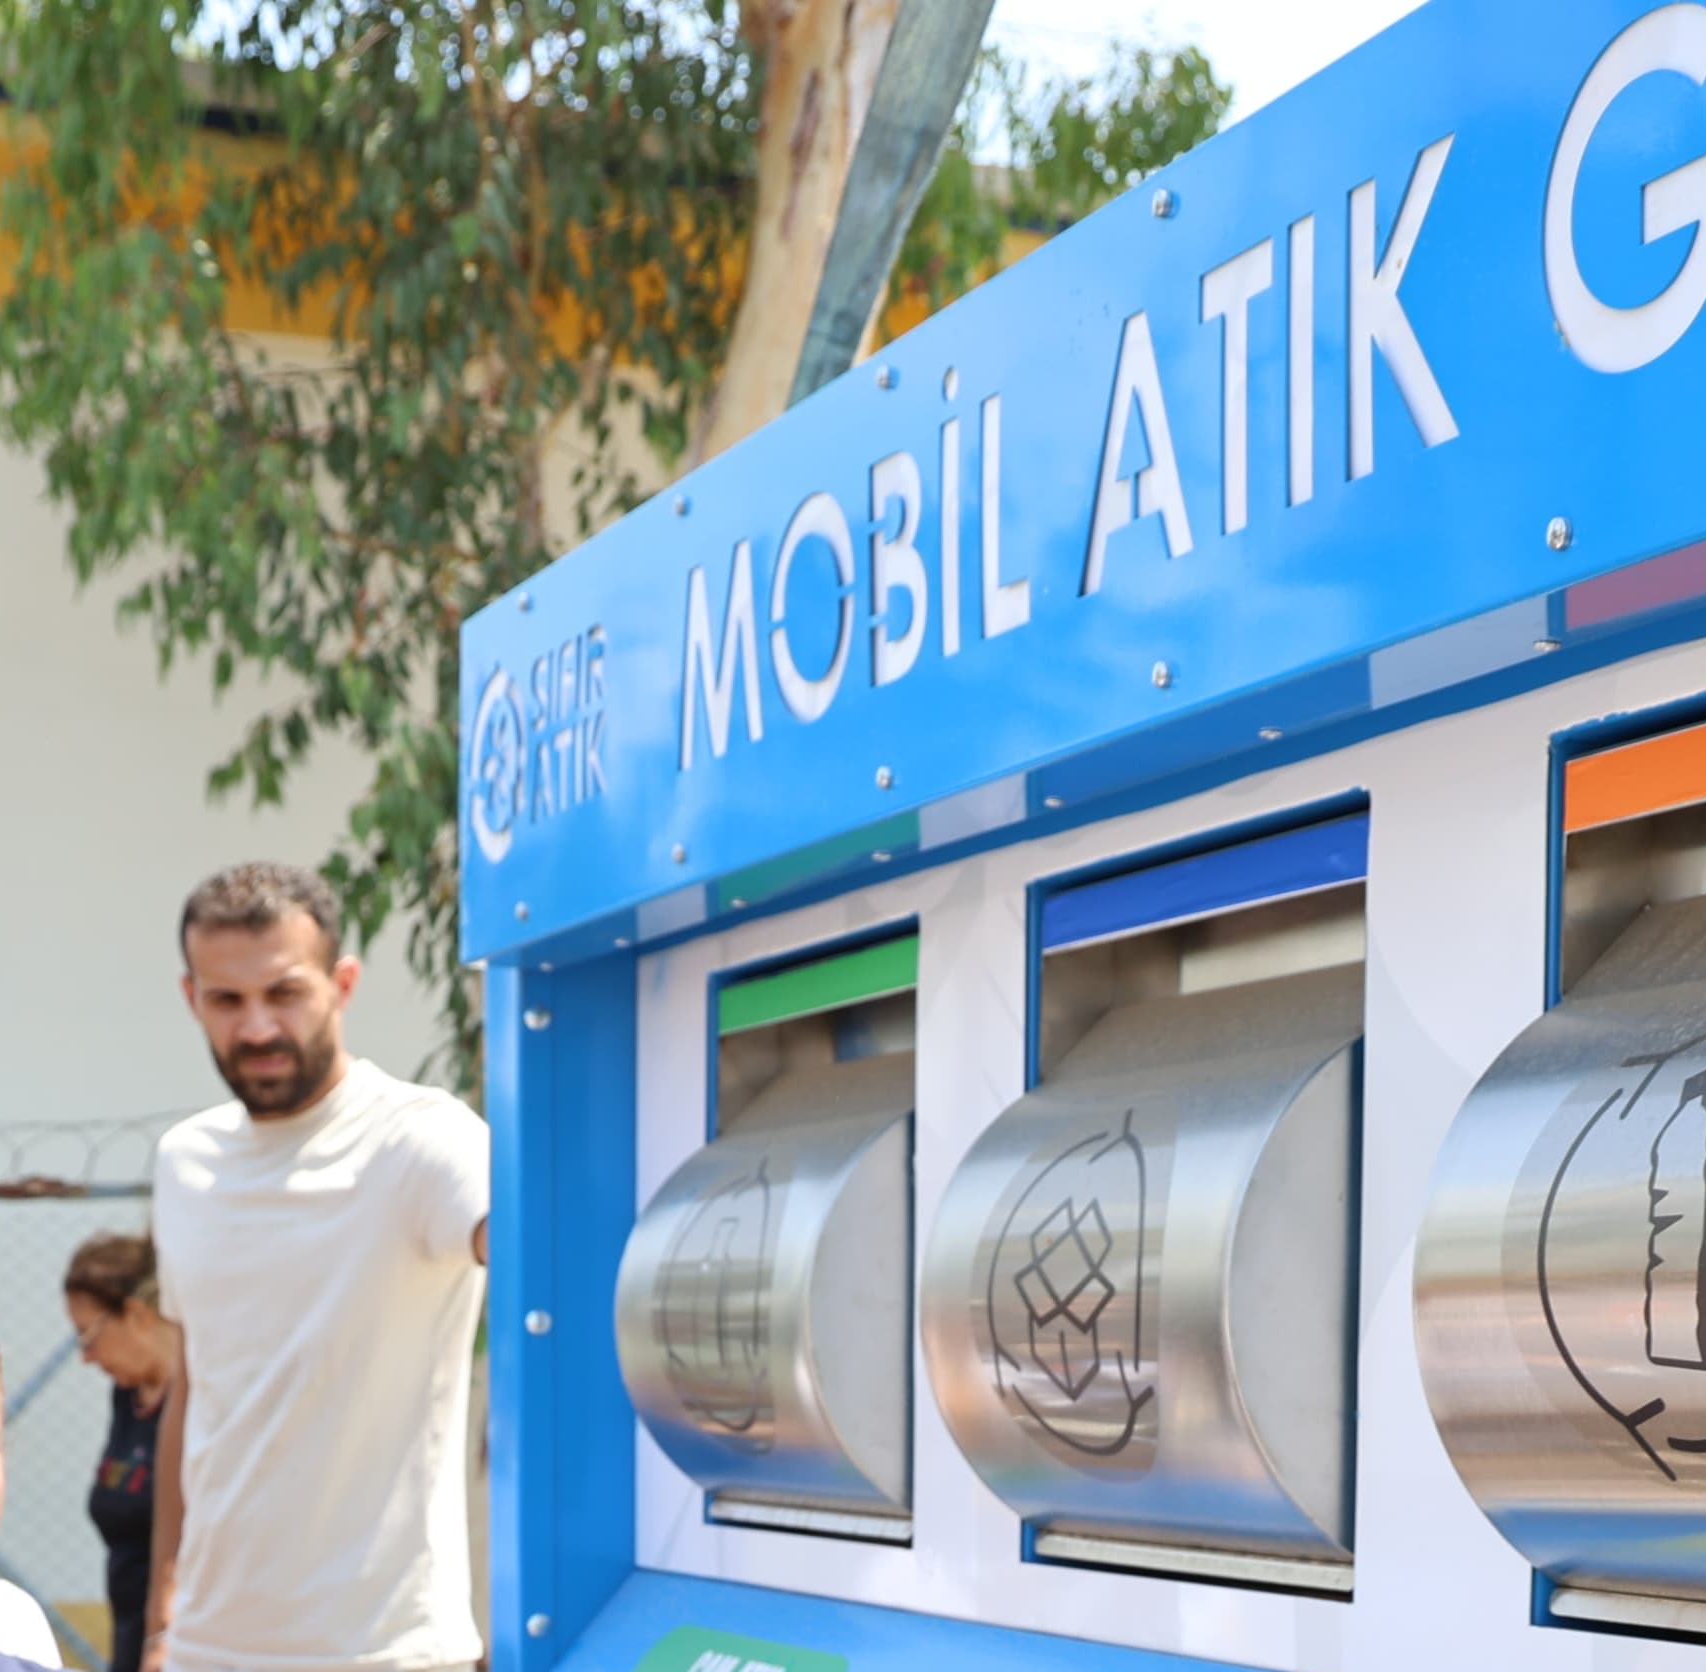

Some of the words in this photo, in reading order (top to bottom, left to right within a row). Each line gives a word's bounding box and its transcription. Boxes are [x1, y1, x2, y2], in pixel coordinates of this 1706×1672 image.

[676, 364, 1031, 772] MOBİL
[1078, 130, 1461, 598] ATIK
[530, 623, 606, 735] SIFIR
[529, 708, 609, 825] ATIK
